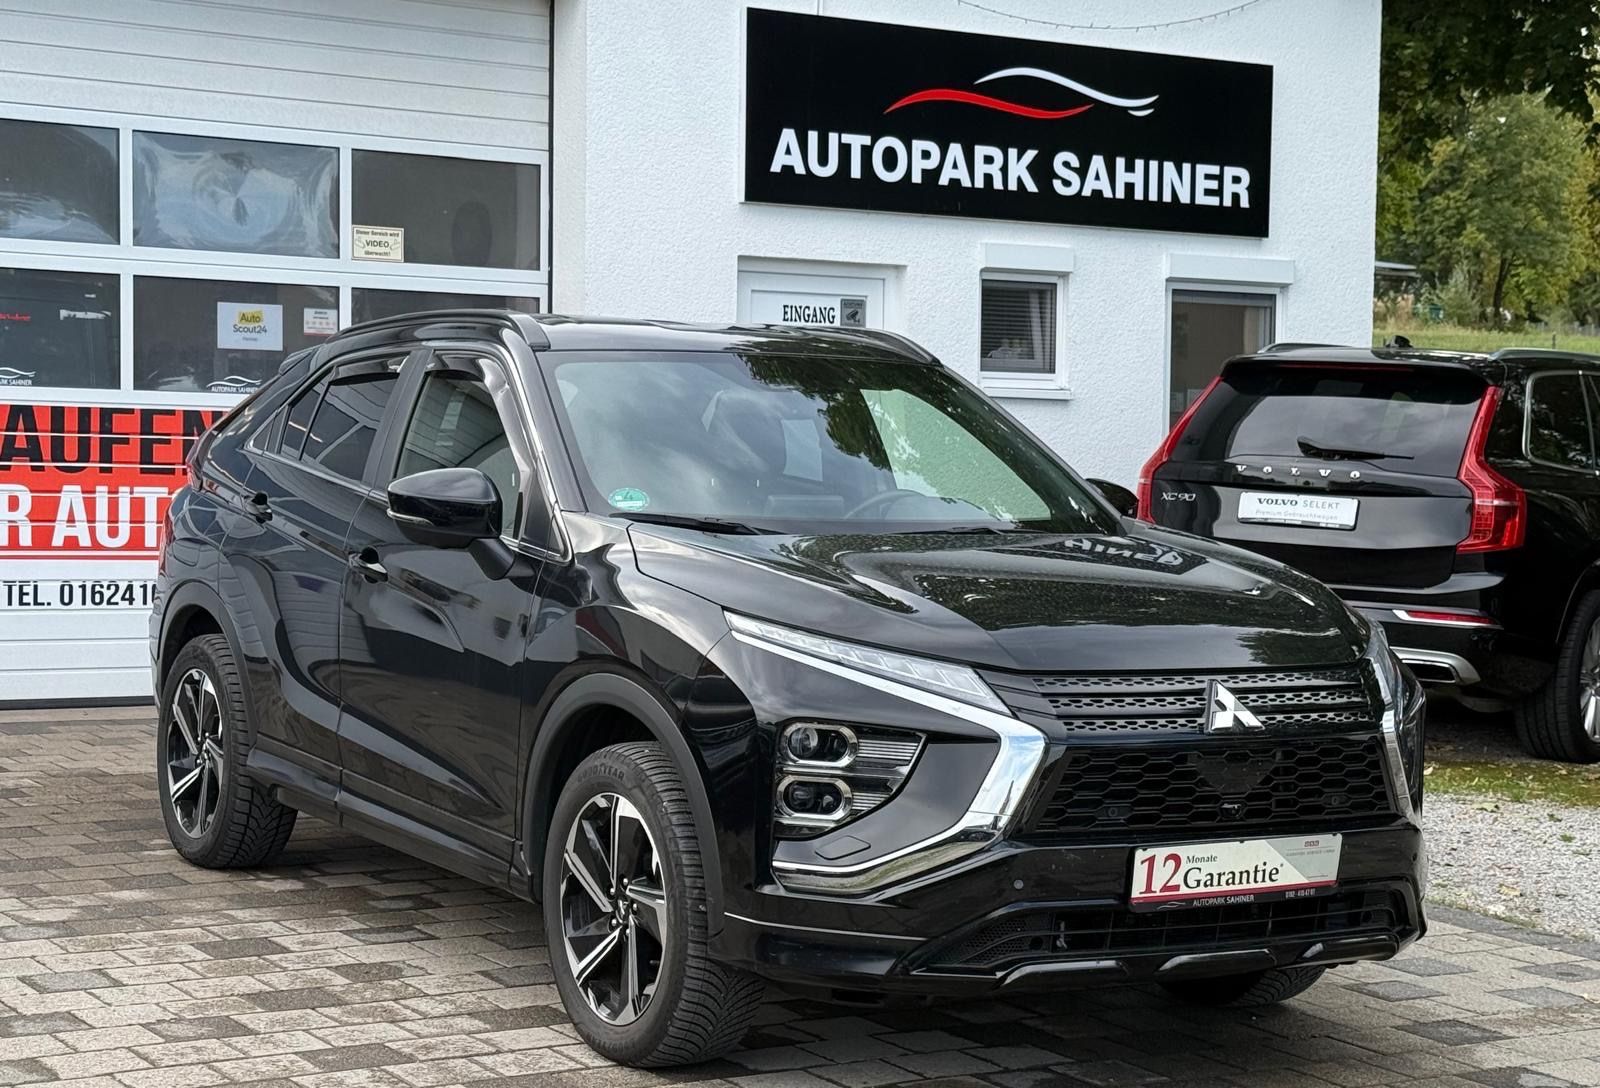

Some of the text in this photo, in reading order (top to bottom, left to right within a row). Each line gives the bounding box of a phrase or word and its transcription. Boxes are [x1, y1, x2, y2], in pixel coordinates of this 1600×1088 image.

[769, 127, 1251, 209] AUTOPARK SAHINER
[365, 239, 390, 248] VIDEO
[239, 312, 261, 324] Auto
[782, 304, 836, 325] EINGANG
[232, 323, 268, 334] Scout24
[1235, 464, 1361, 479] VOLVO
[1160, 491, 1196, 502] XC90
[1257, 497, 1341, 510] VOLVO SELEKT
[51, 484, 184, 548] AUT
[2, 580, 156, 607] TEL. 016241
[1139, 852, 1218, 895] 12 Monate
[1192, 895, 1255, 907] AUTOPARK SAHINER
